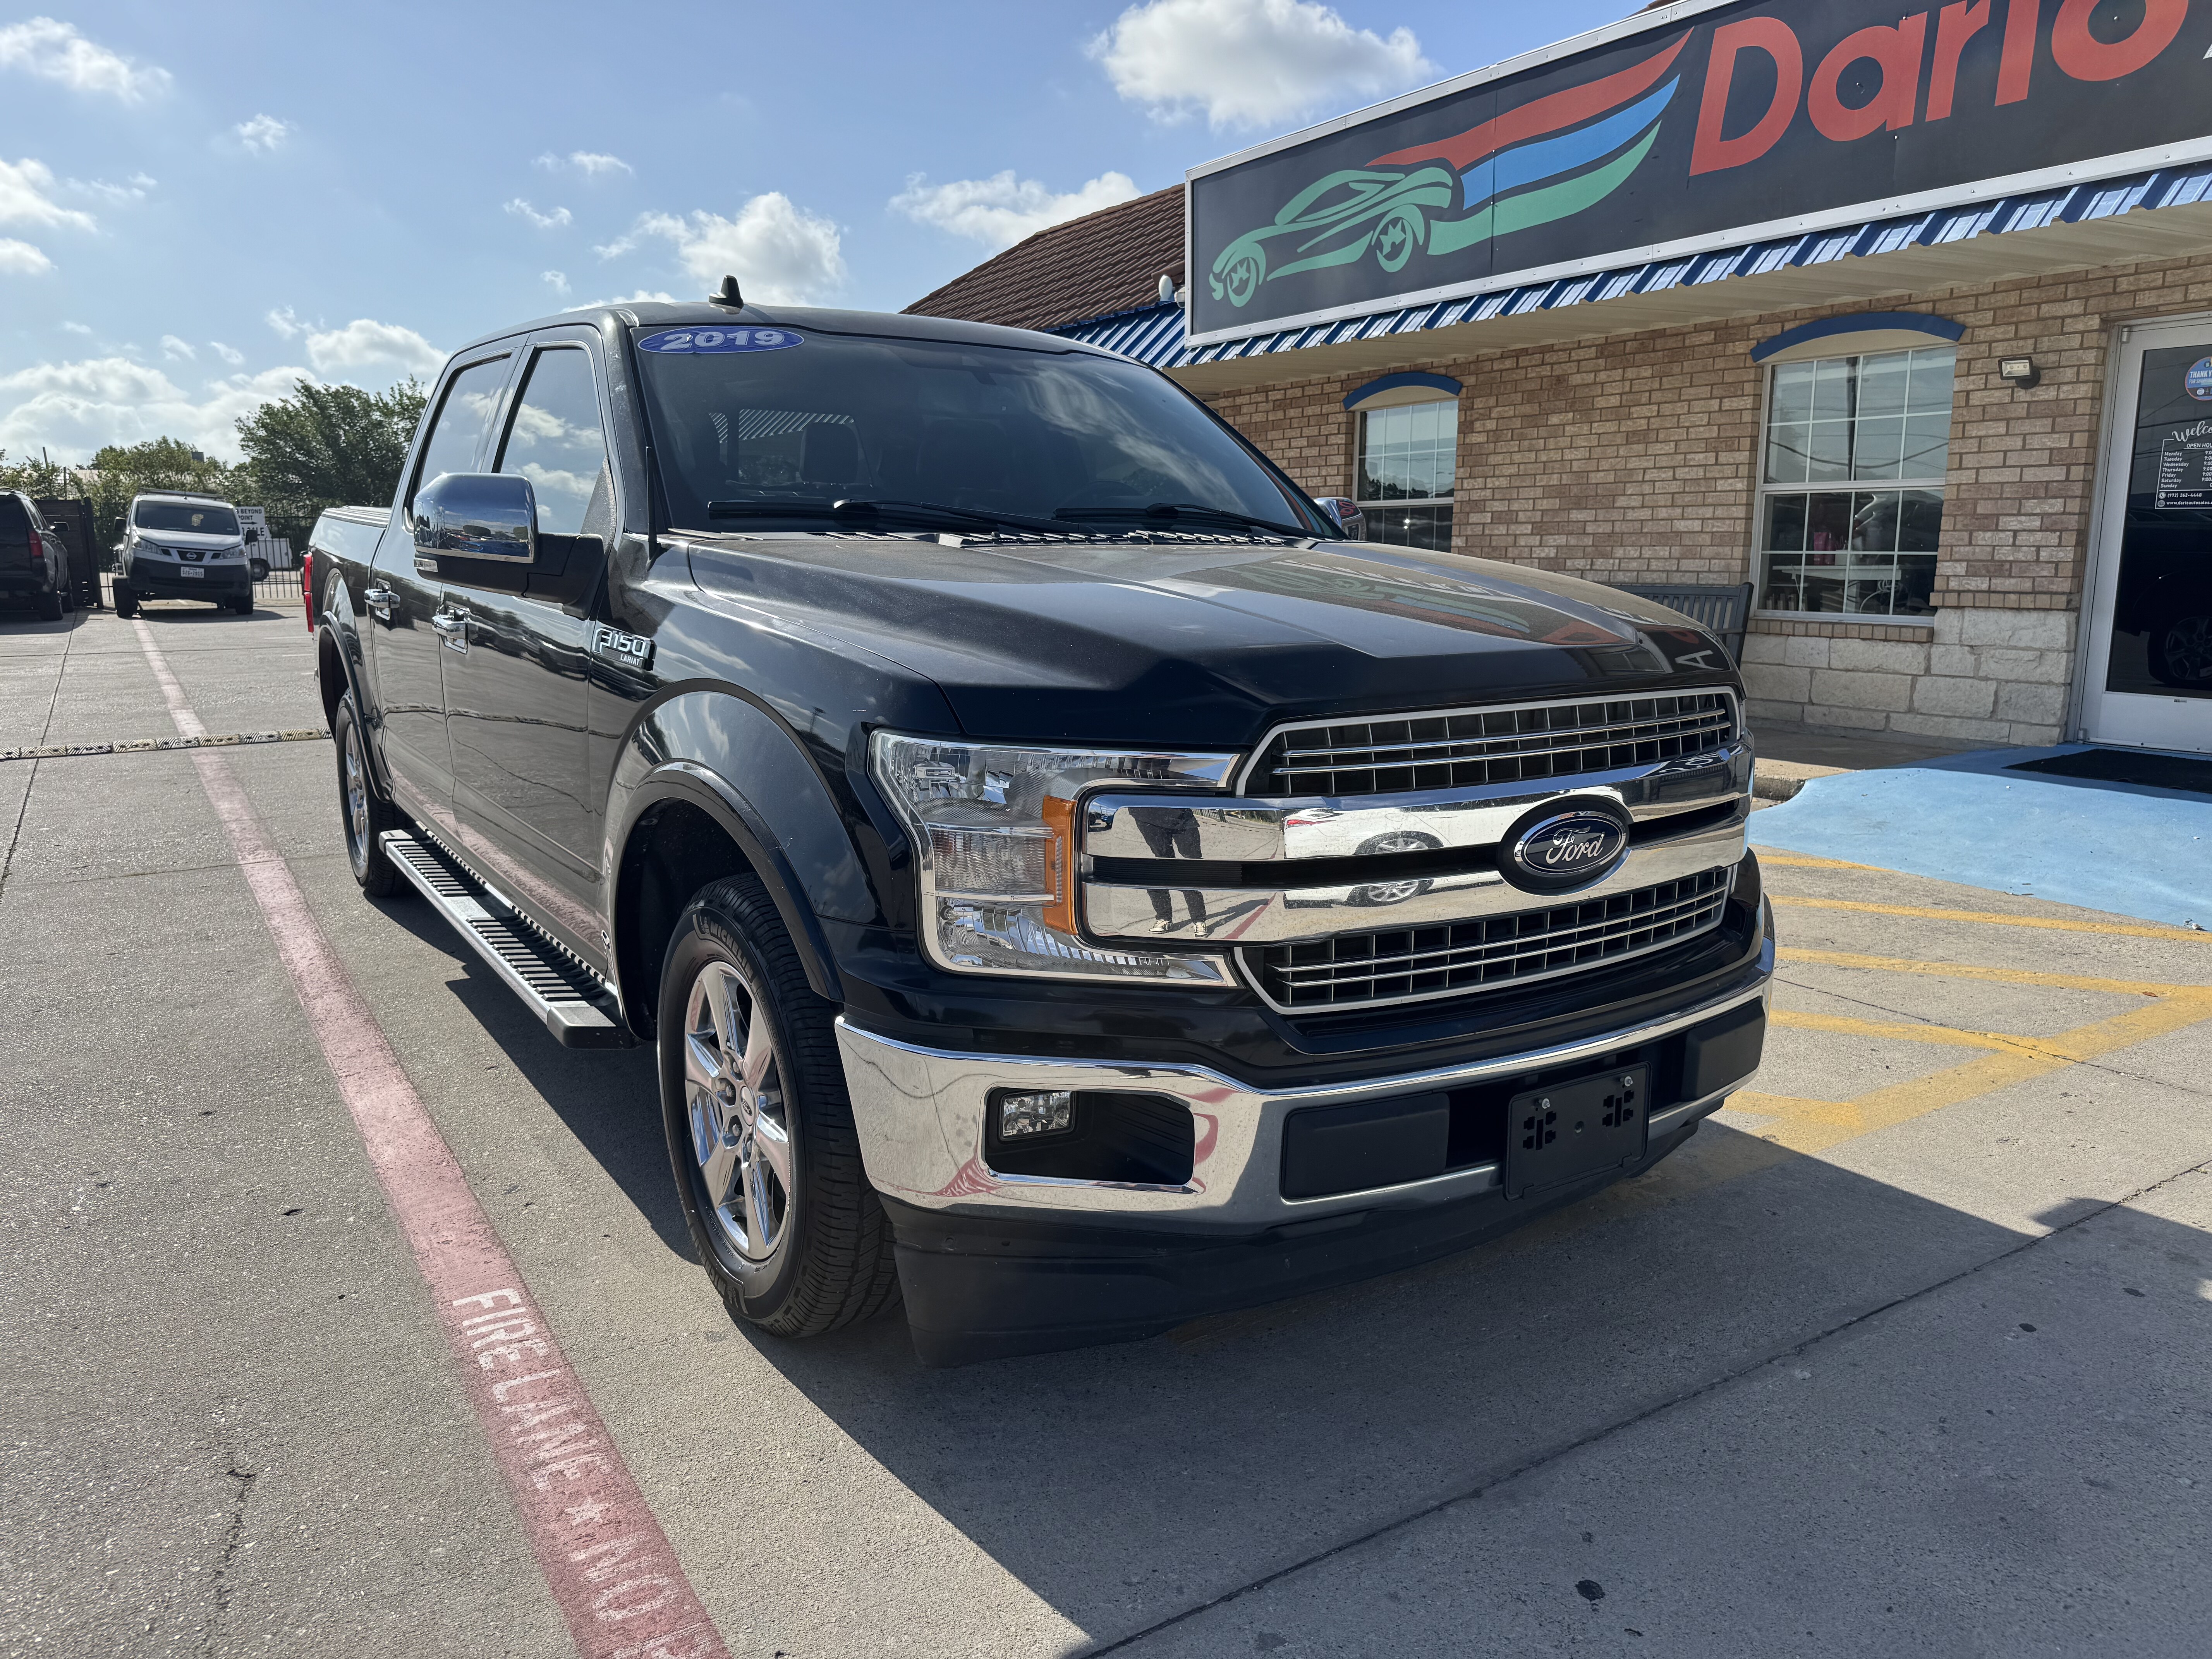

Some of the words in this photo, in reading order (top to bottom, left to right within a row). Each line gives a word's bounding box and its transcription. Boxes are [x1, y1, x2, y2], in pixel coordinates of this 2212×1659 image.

[1689, 0, 2189, 176] Dario
[660, 331, 785, 350] 2019
[2190, 370, 2208, 378] THANK
[2172, 421, 2212, 442] Welco
[620, 654, 640, 666] LARIAT
[1546, 826, 1605, 864] Ford
[710, 921, 754, 979] MICHELIN
[742, 1099, 750, 1114] Ford
[452, 1288, 550, 1370] FIRE
[492, 1369, 613, 1492] LANE
[568, 1531, 679, 1621] NO
